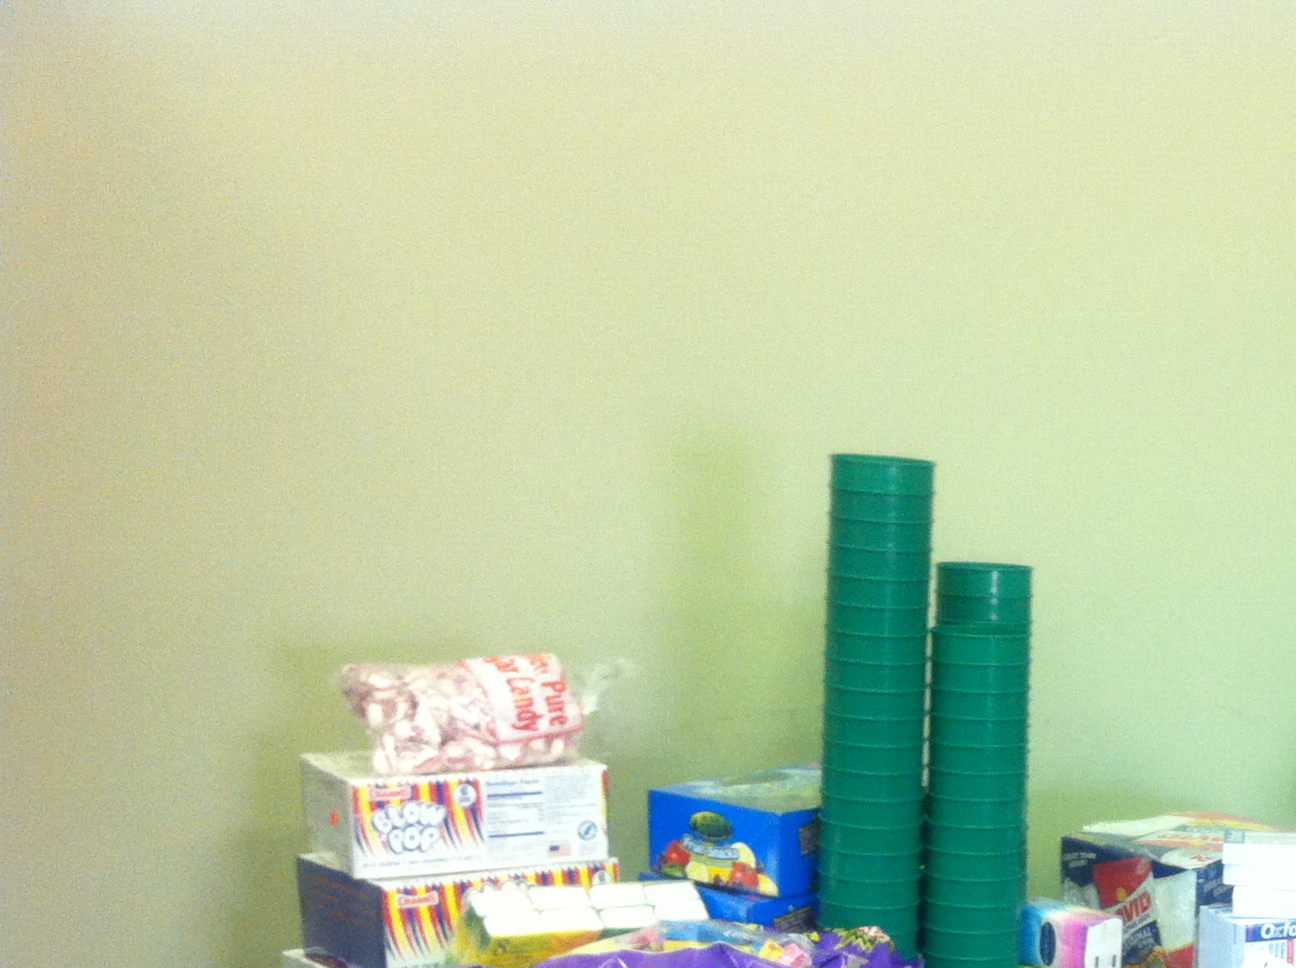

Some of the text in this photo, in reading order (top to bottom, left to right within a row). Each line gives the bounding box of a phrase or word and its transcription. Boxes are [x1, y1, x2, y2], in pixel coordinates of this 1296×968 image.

[506, 677, 545, 731] Candy
[541, 679, 569, 727] Pure
[372, 801, 448, 834] BLOW
[387, 826, 441, 854] POP
